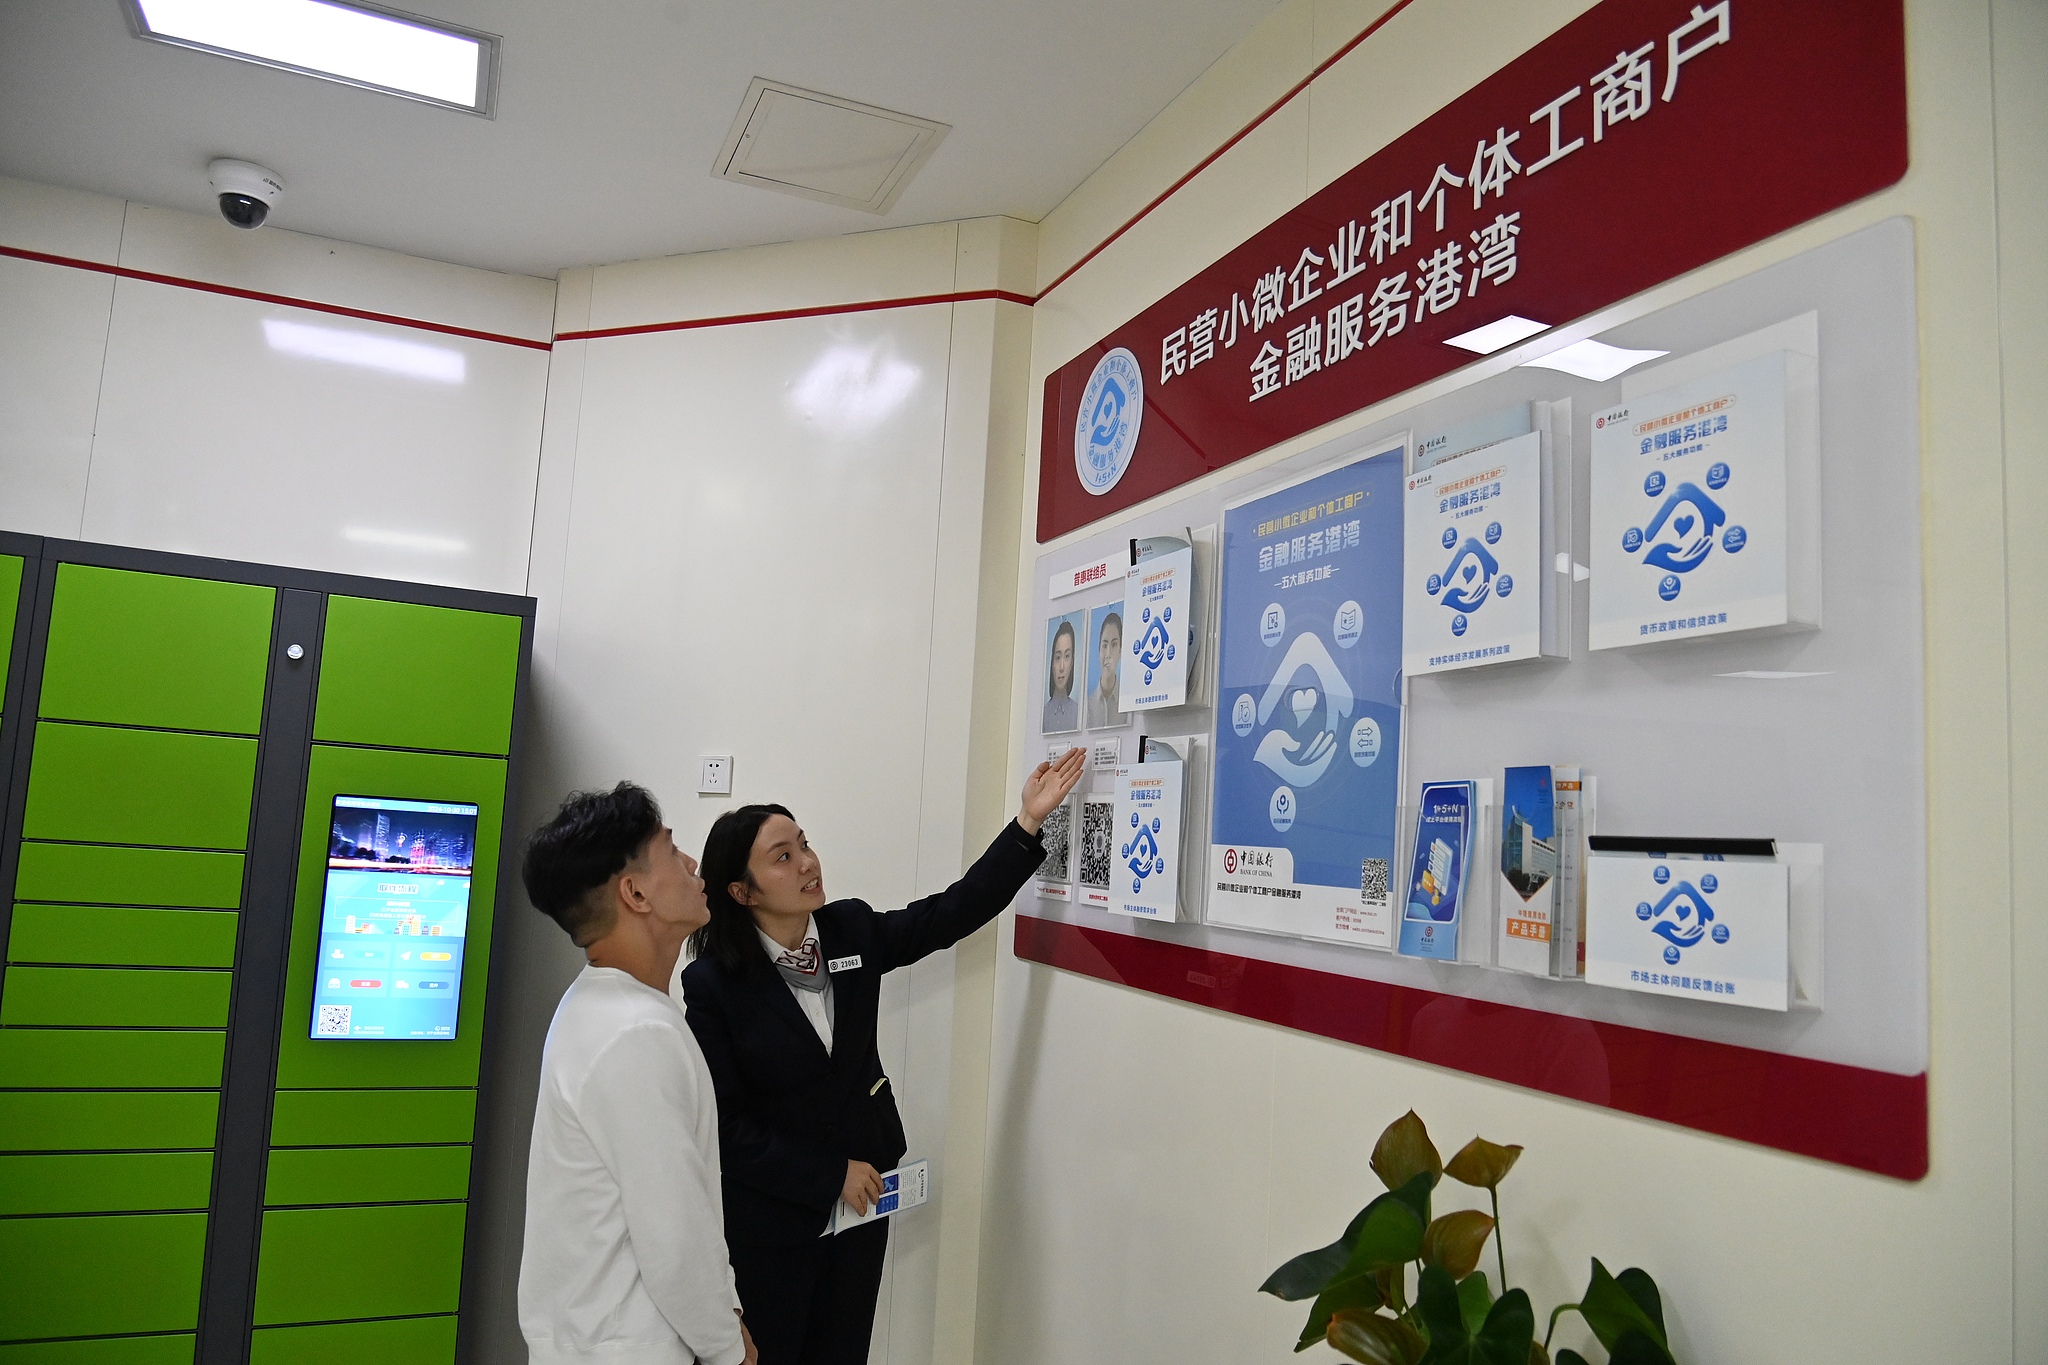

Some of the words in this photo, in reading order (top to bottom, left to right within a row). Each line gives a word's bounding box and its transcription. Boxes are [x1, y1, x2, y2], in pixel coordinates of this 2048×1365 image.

[1160, 2, 1732, 386] 民营小微企业和个体工商户
[1247, 212, 1523, 404] 金融服务港湾
[1639, 414, 1729, 456] 金融服务港湾
[1439, 482, 1501, 514] 金融服务港湾
[1257, 491, 1364, 538] 民营小微企业和个体工商户
[1258, 520, 1361, 573] 金融服务港湾
[1074, 563, 1107, 587] 普惠联络员
[1281, 564, 1332, 589] 五大服务功能
[1640, 613, 1728, 636] 货币政策和信贷政策
[1429, 645, 1511, 667] 支持实体经济发展系列政策
[1433, 803, 1459, 814] 1+5+N
[1240, 850, 1274, 869] 中国银行
[1240, 868, 1252, 876] BANK
[1252, 869, 1258, 877] OF
[1258, 870, 1273, 878] CHINA
[1511, 921, 1547, 939] 产品手册
[841, 958, 859, 969] 23063
[1630, 970, 1736, 995] 市场主体问题反馈台账
